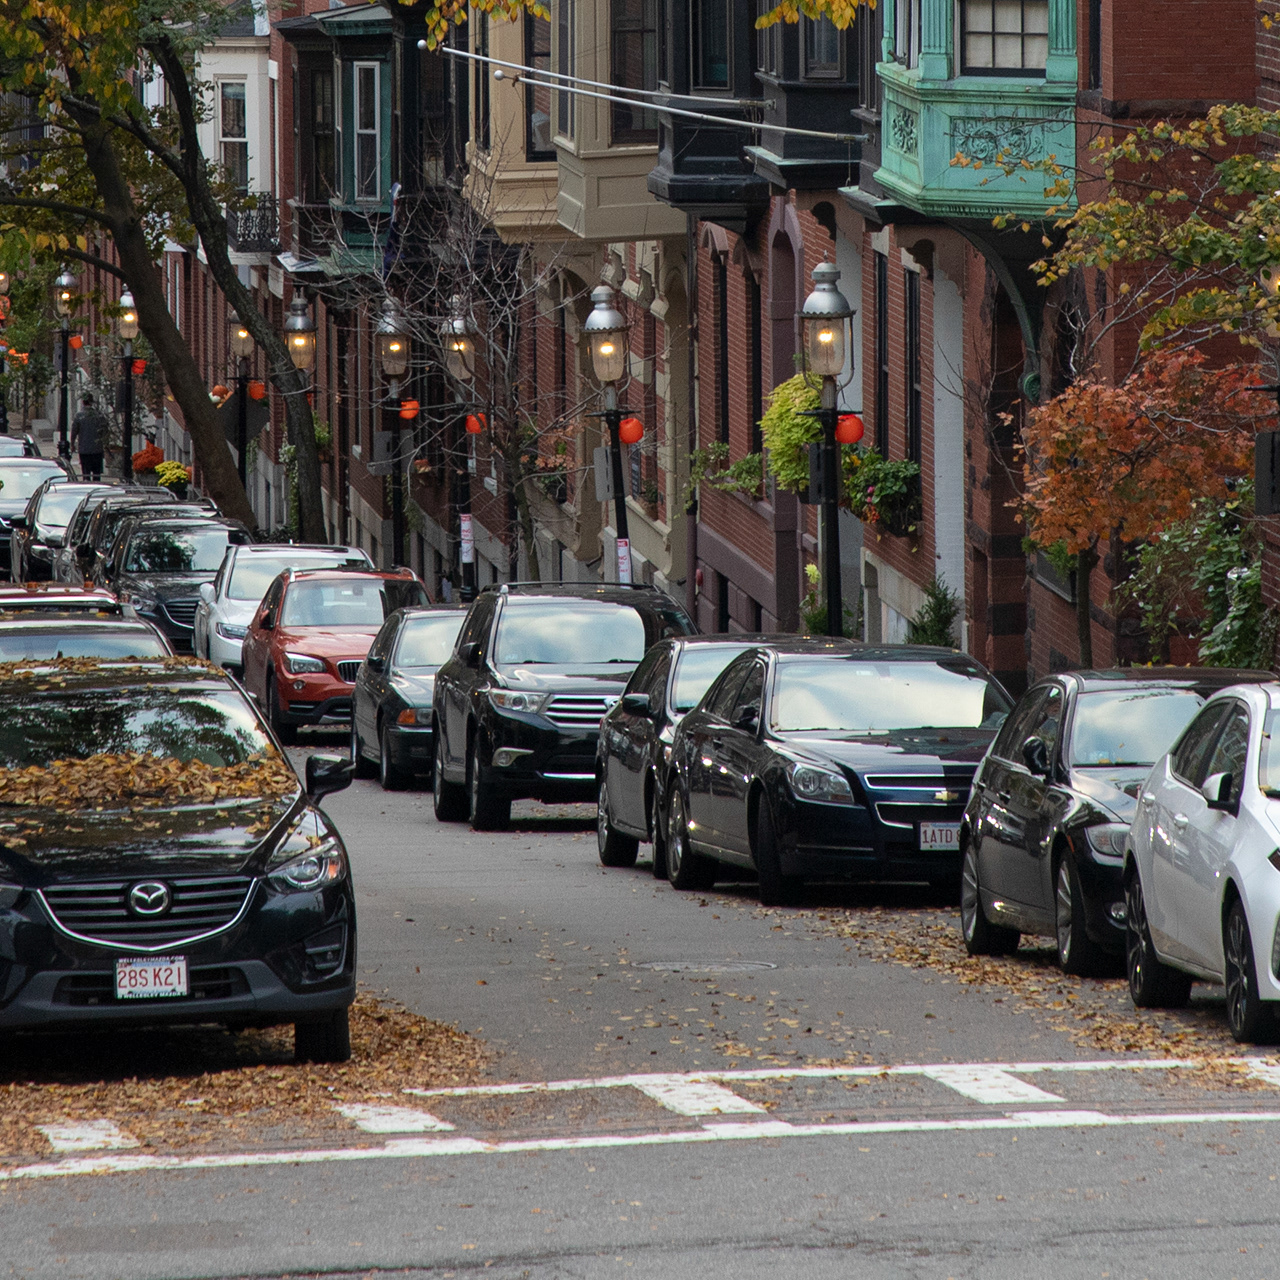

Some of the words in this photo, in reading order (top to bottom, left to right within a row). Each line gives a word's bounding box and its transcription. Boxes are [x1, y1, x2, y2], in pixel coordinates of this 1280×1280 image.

[922, 829, 953, 844] 1ATD
[118, 968, 149, 989] 28S
[153, 966, 182, 987] K21
